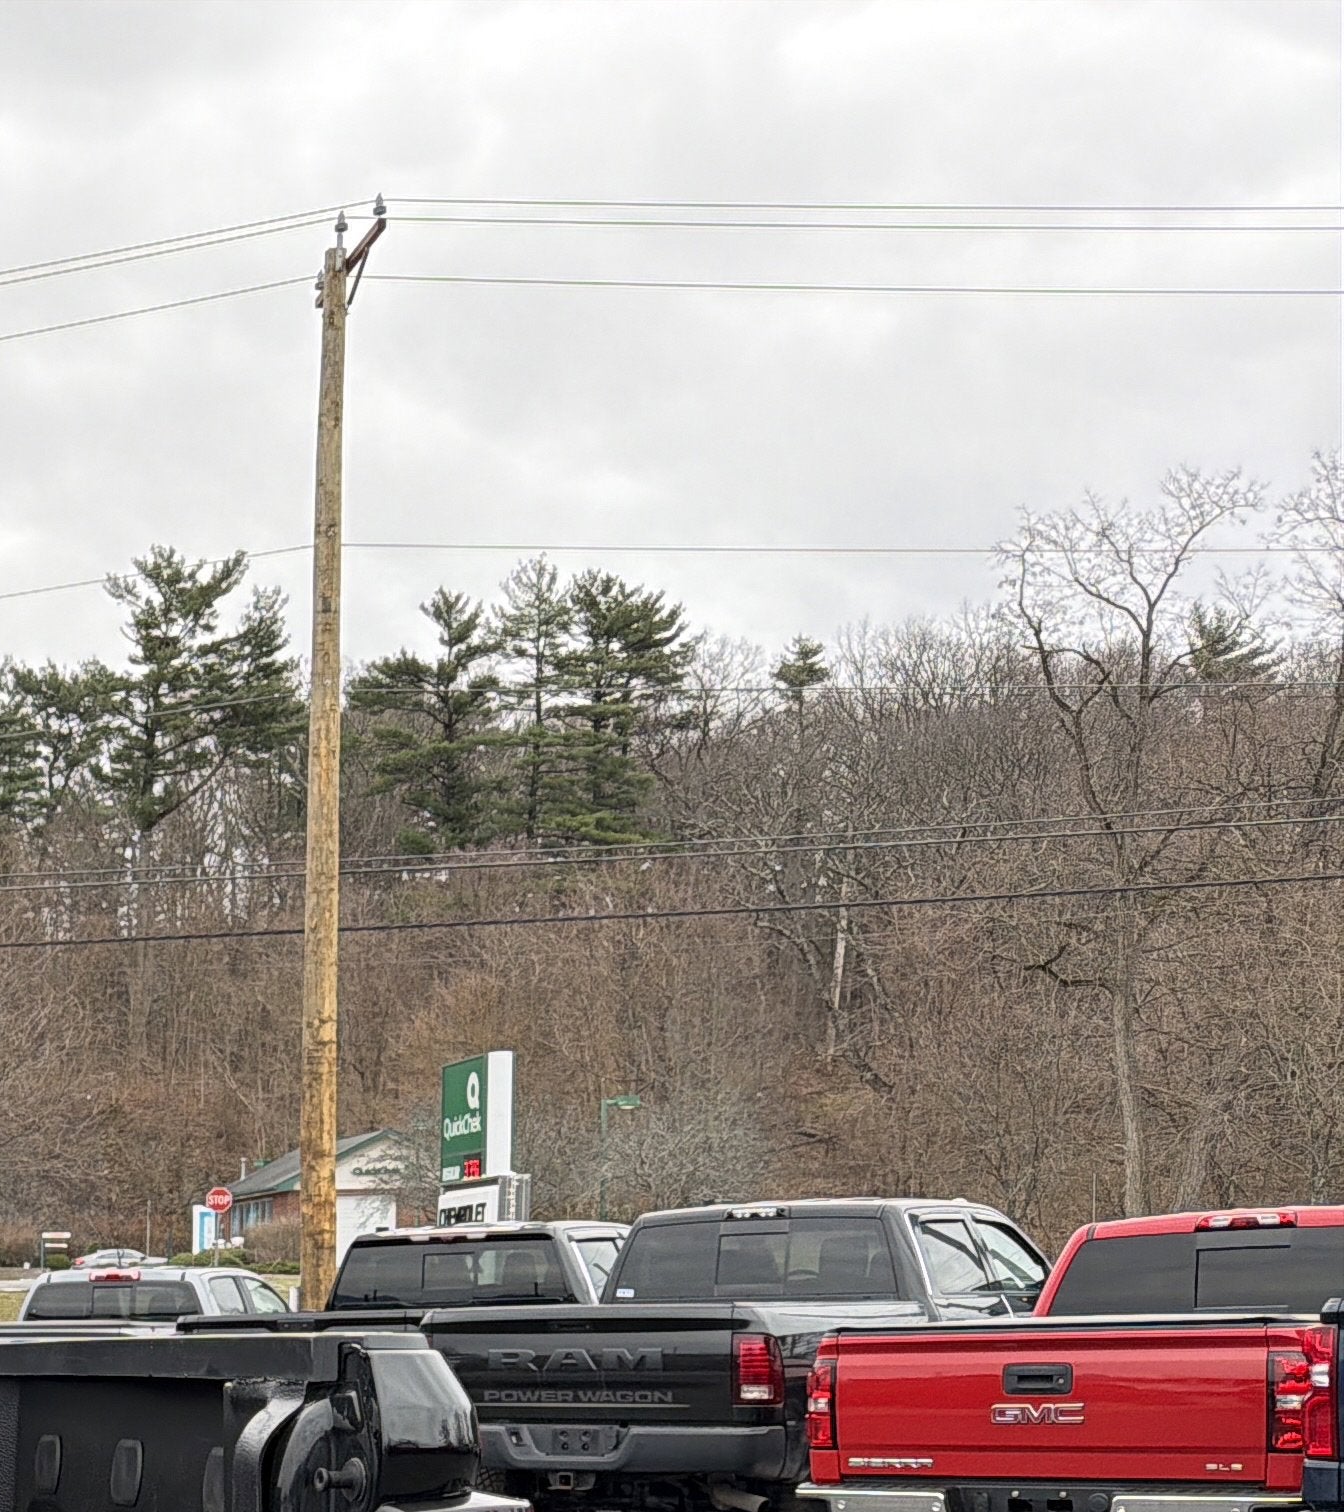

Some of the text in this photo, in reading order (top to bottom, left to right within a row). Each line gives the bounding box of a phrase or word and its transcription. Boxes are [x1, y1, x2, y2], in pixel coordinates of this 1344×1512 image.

[443, 1110, 482, 1141] QuickChek
[208, 1194, 231, 1206] STOP
[487, 1347, 663, 1371] RAM
[483, 1389, 673, 1403] POWER WAGON
[990, 1402, 1085, 1425] GMC
[848, 1457, 934, 1469] SIERRA
